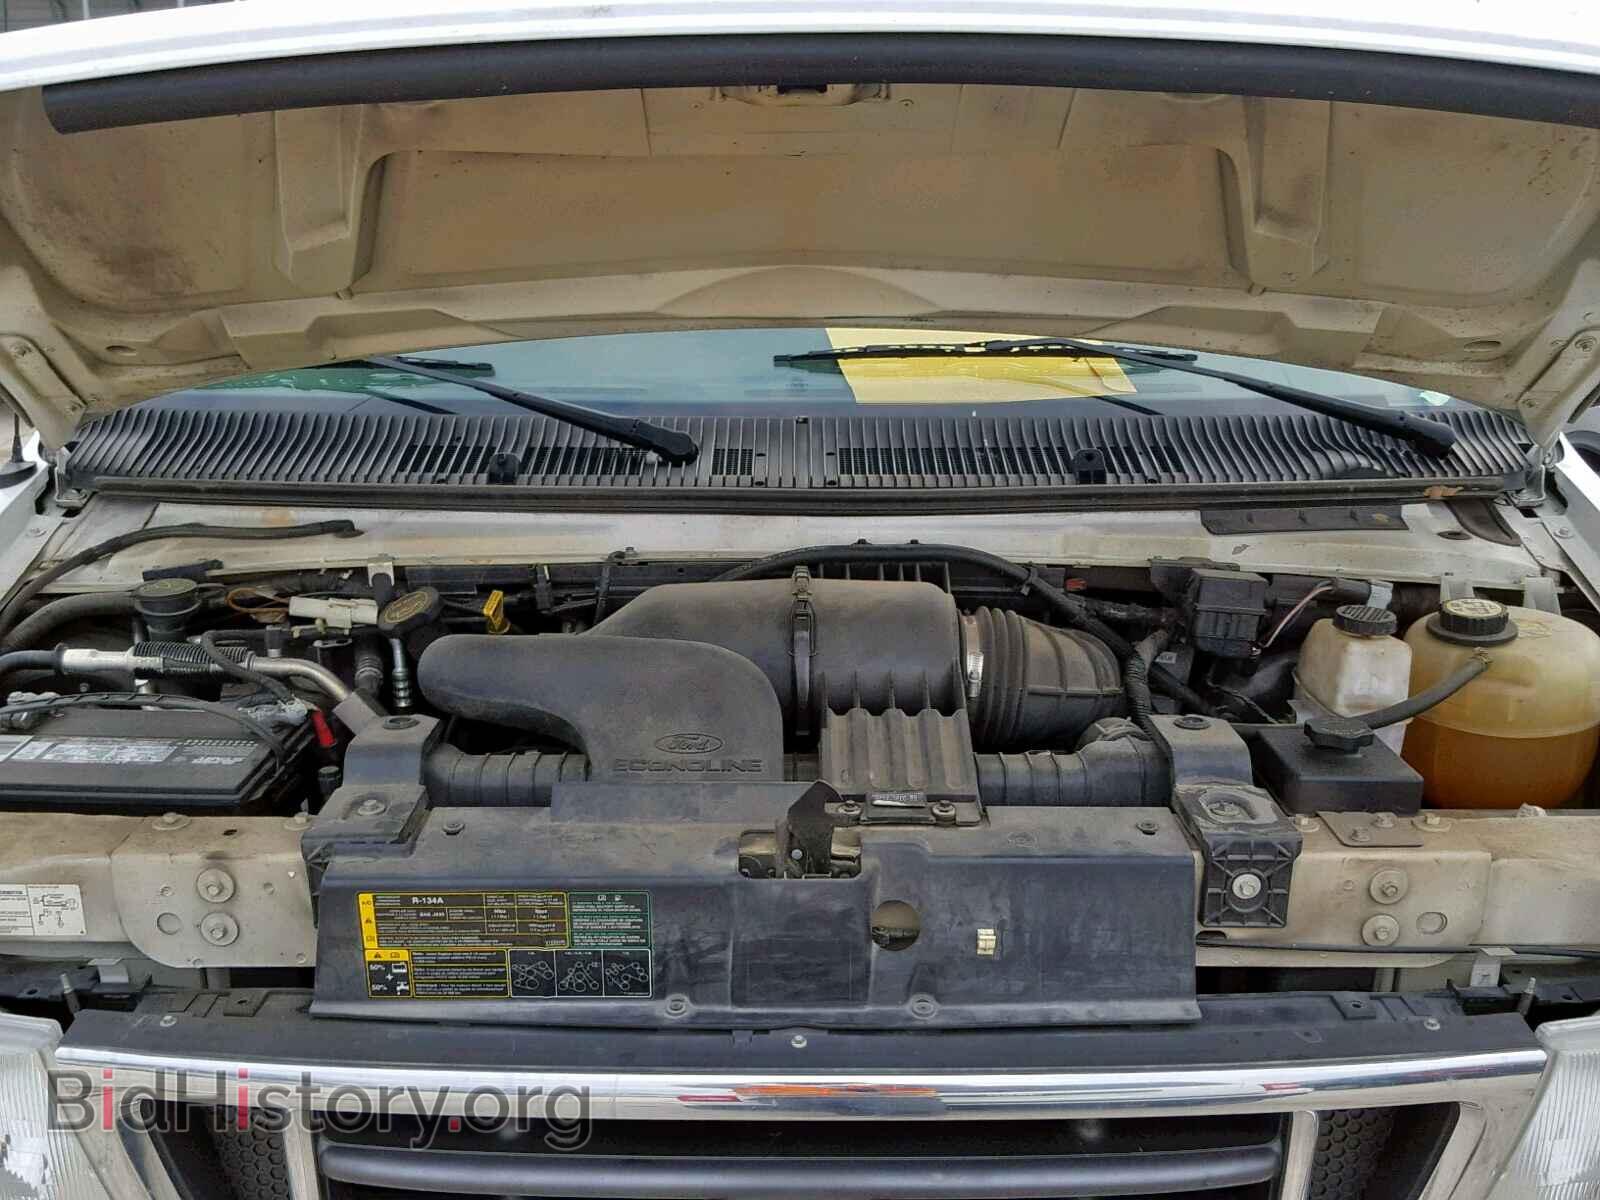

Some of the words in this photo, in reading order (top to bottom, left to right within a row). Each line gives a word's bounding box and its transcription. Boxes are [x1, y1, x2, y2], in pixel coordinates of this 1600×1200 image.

[667, 736, 710, 751] Ford
[612, 758, 762, 772] ECONOLINE
[411, 896, 445, 905] R-134A
[370, 963, 386, 971] 50%
[371, 983, 388, 991] 50%
